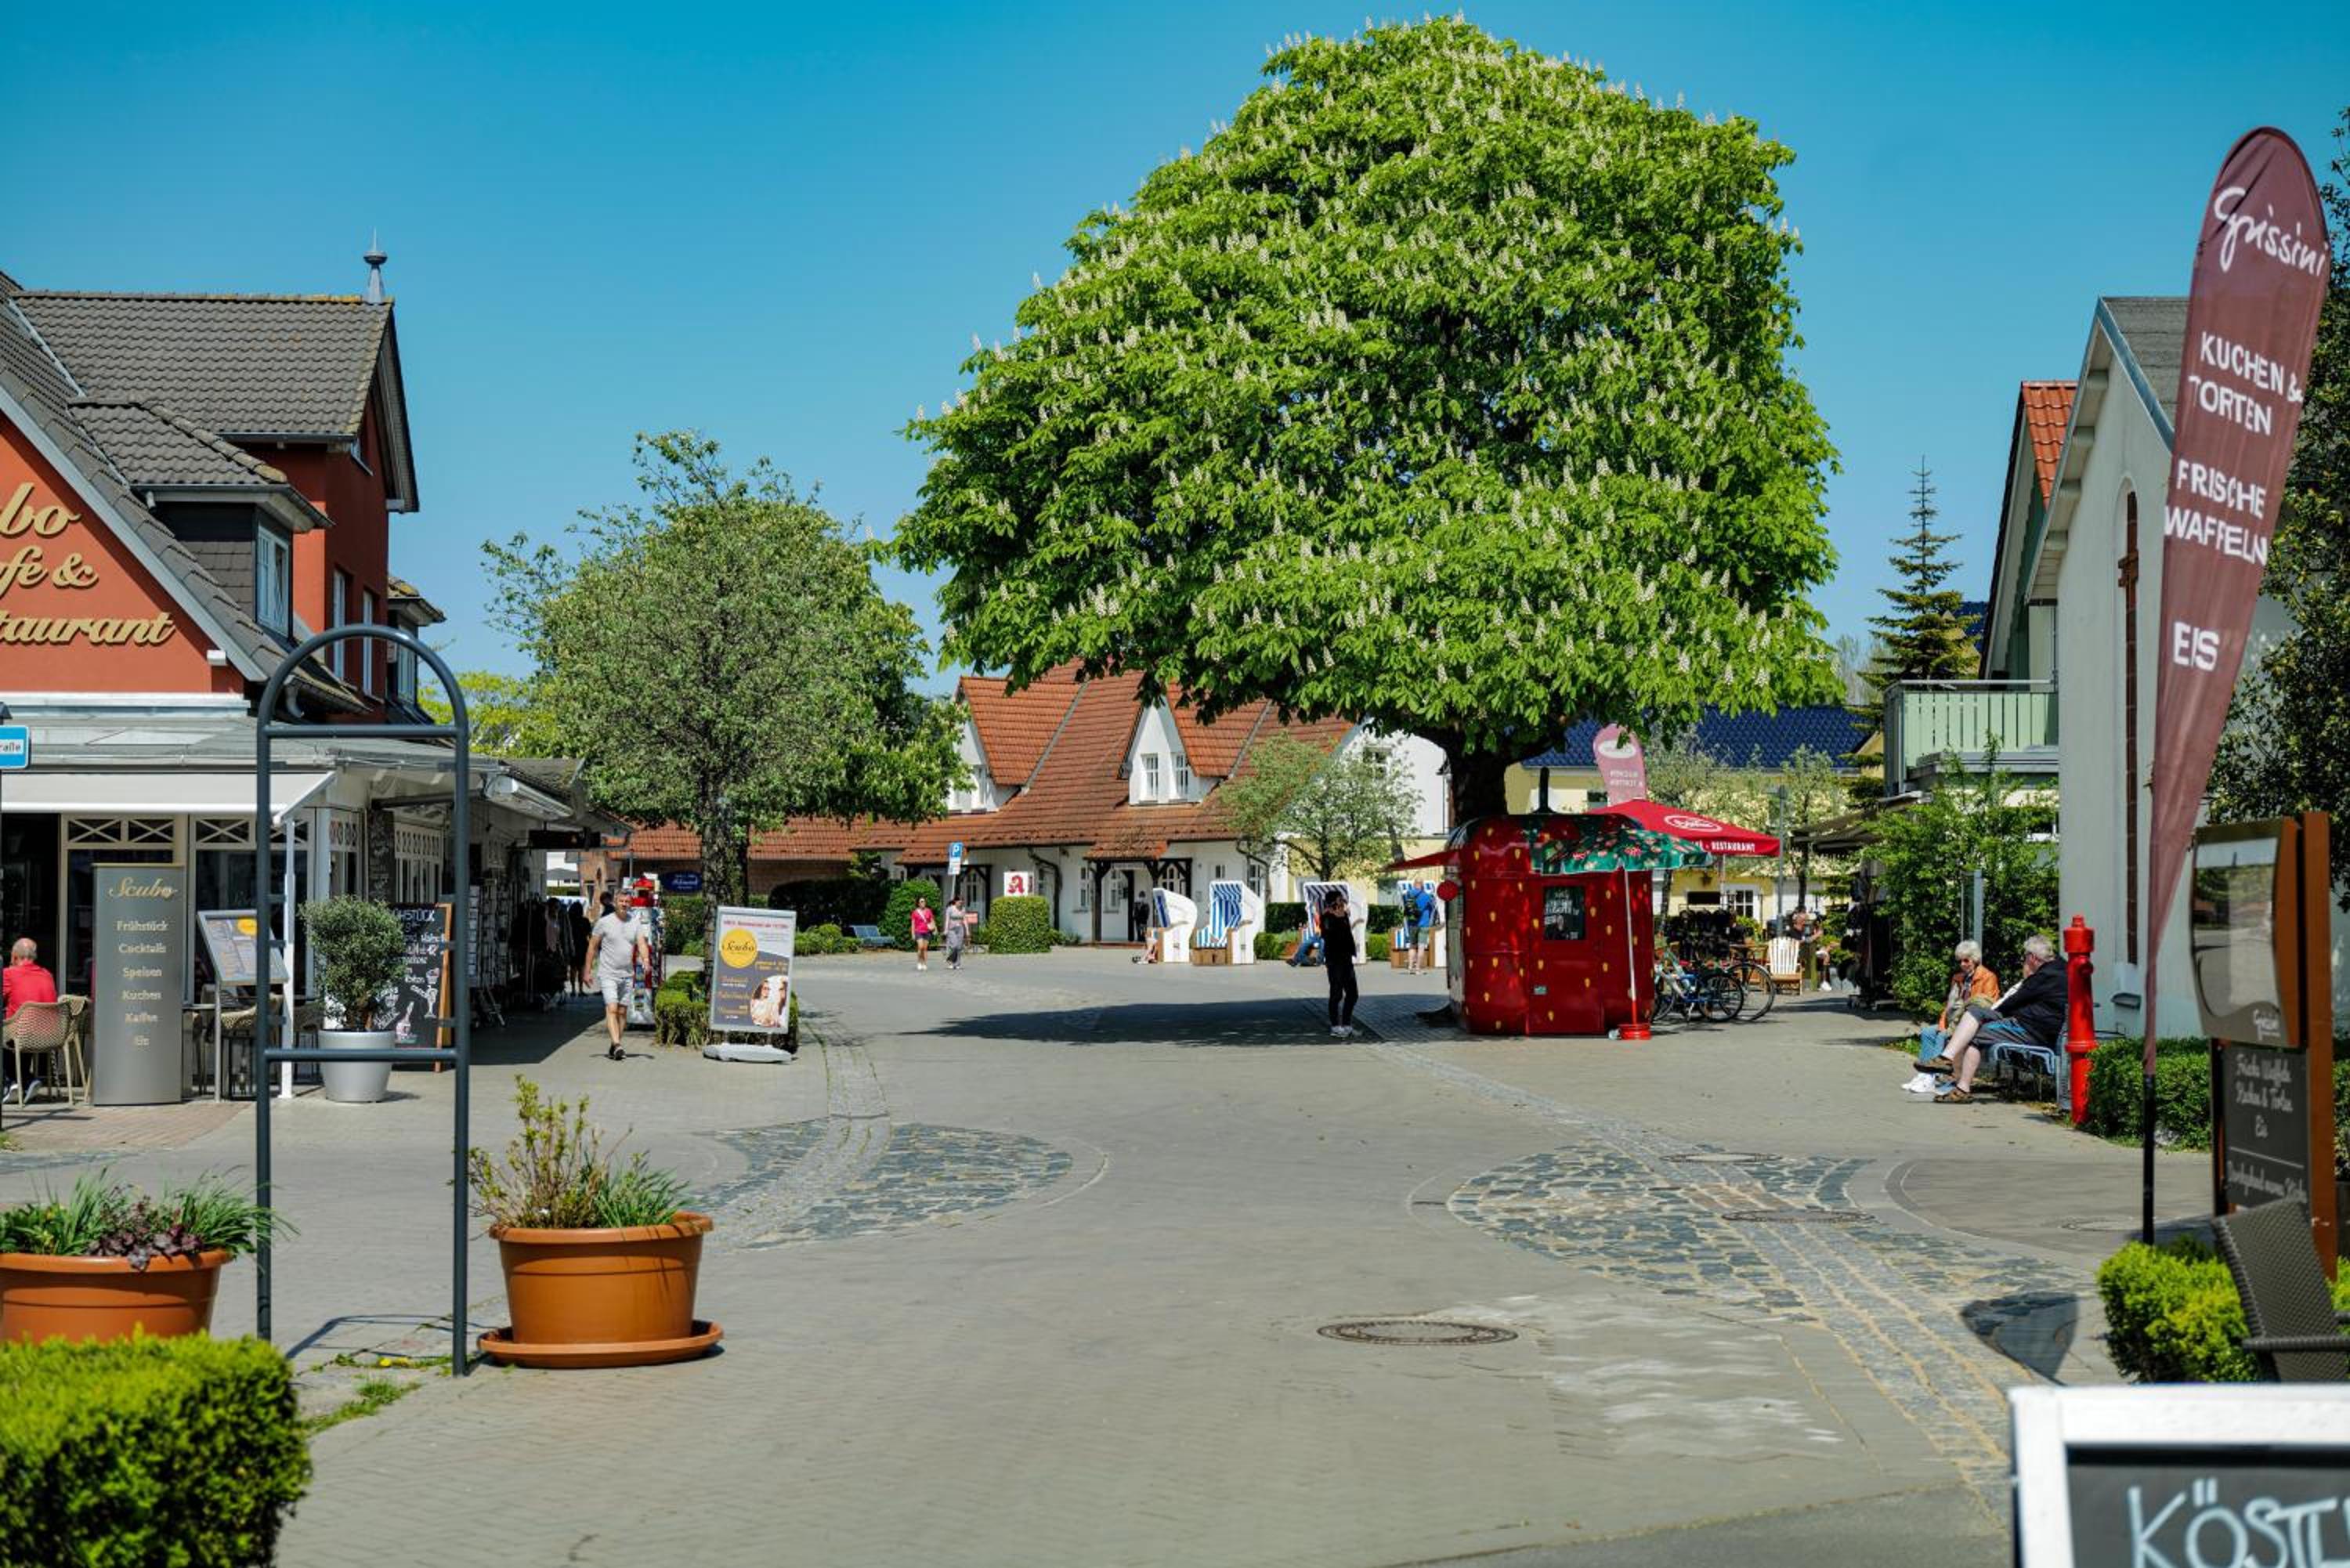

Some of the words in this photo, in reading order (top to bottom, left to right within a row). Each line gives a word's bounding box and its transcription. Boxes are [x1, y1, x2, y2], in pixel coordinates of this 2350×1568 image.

[2200, 331, 2284, 396] KUCHEN
[2287, 371, 2305, 403] &
[2176, 458, 2266, 520] FRISCHE
[2164, 505, 2269, 566] WAFFELN
[52, 552, 99, 587] &
[2172, 622, 2220, 672] EIS
[1711, 840, 1755, 853] RESTAURANT
[107, 876, 179, 899] Scubo
[116, 919, 168, 932] Frühstück
[118, 942, 167, 954] Cocktails
[122, 966, 163, 981] Speisen
